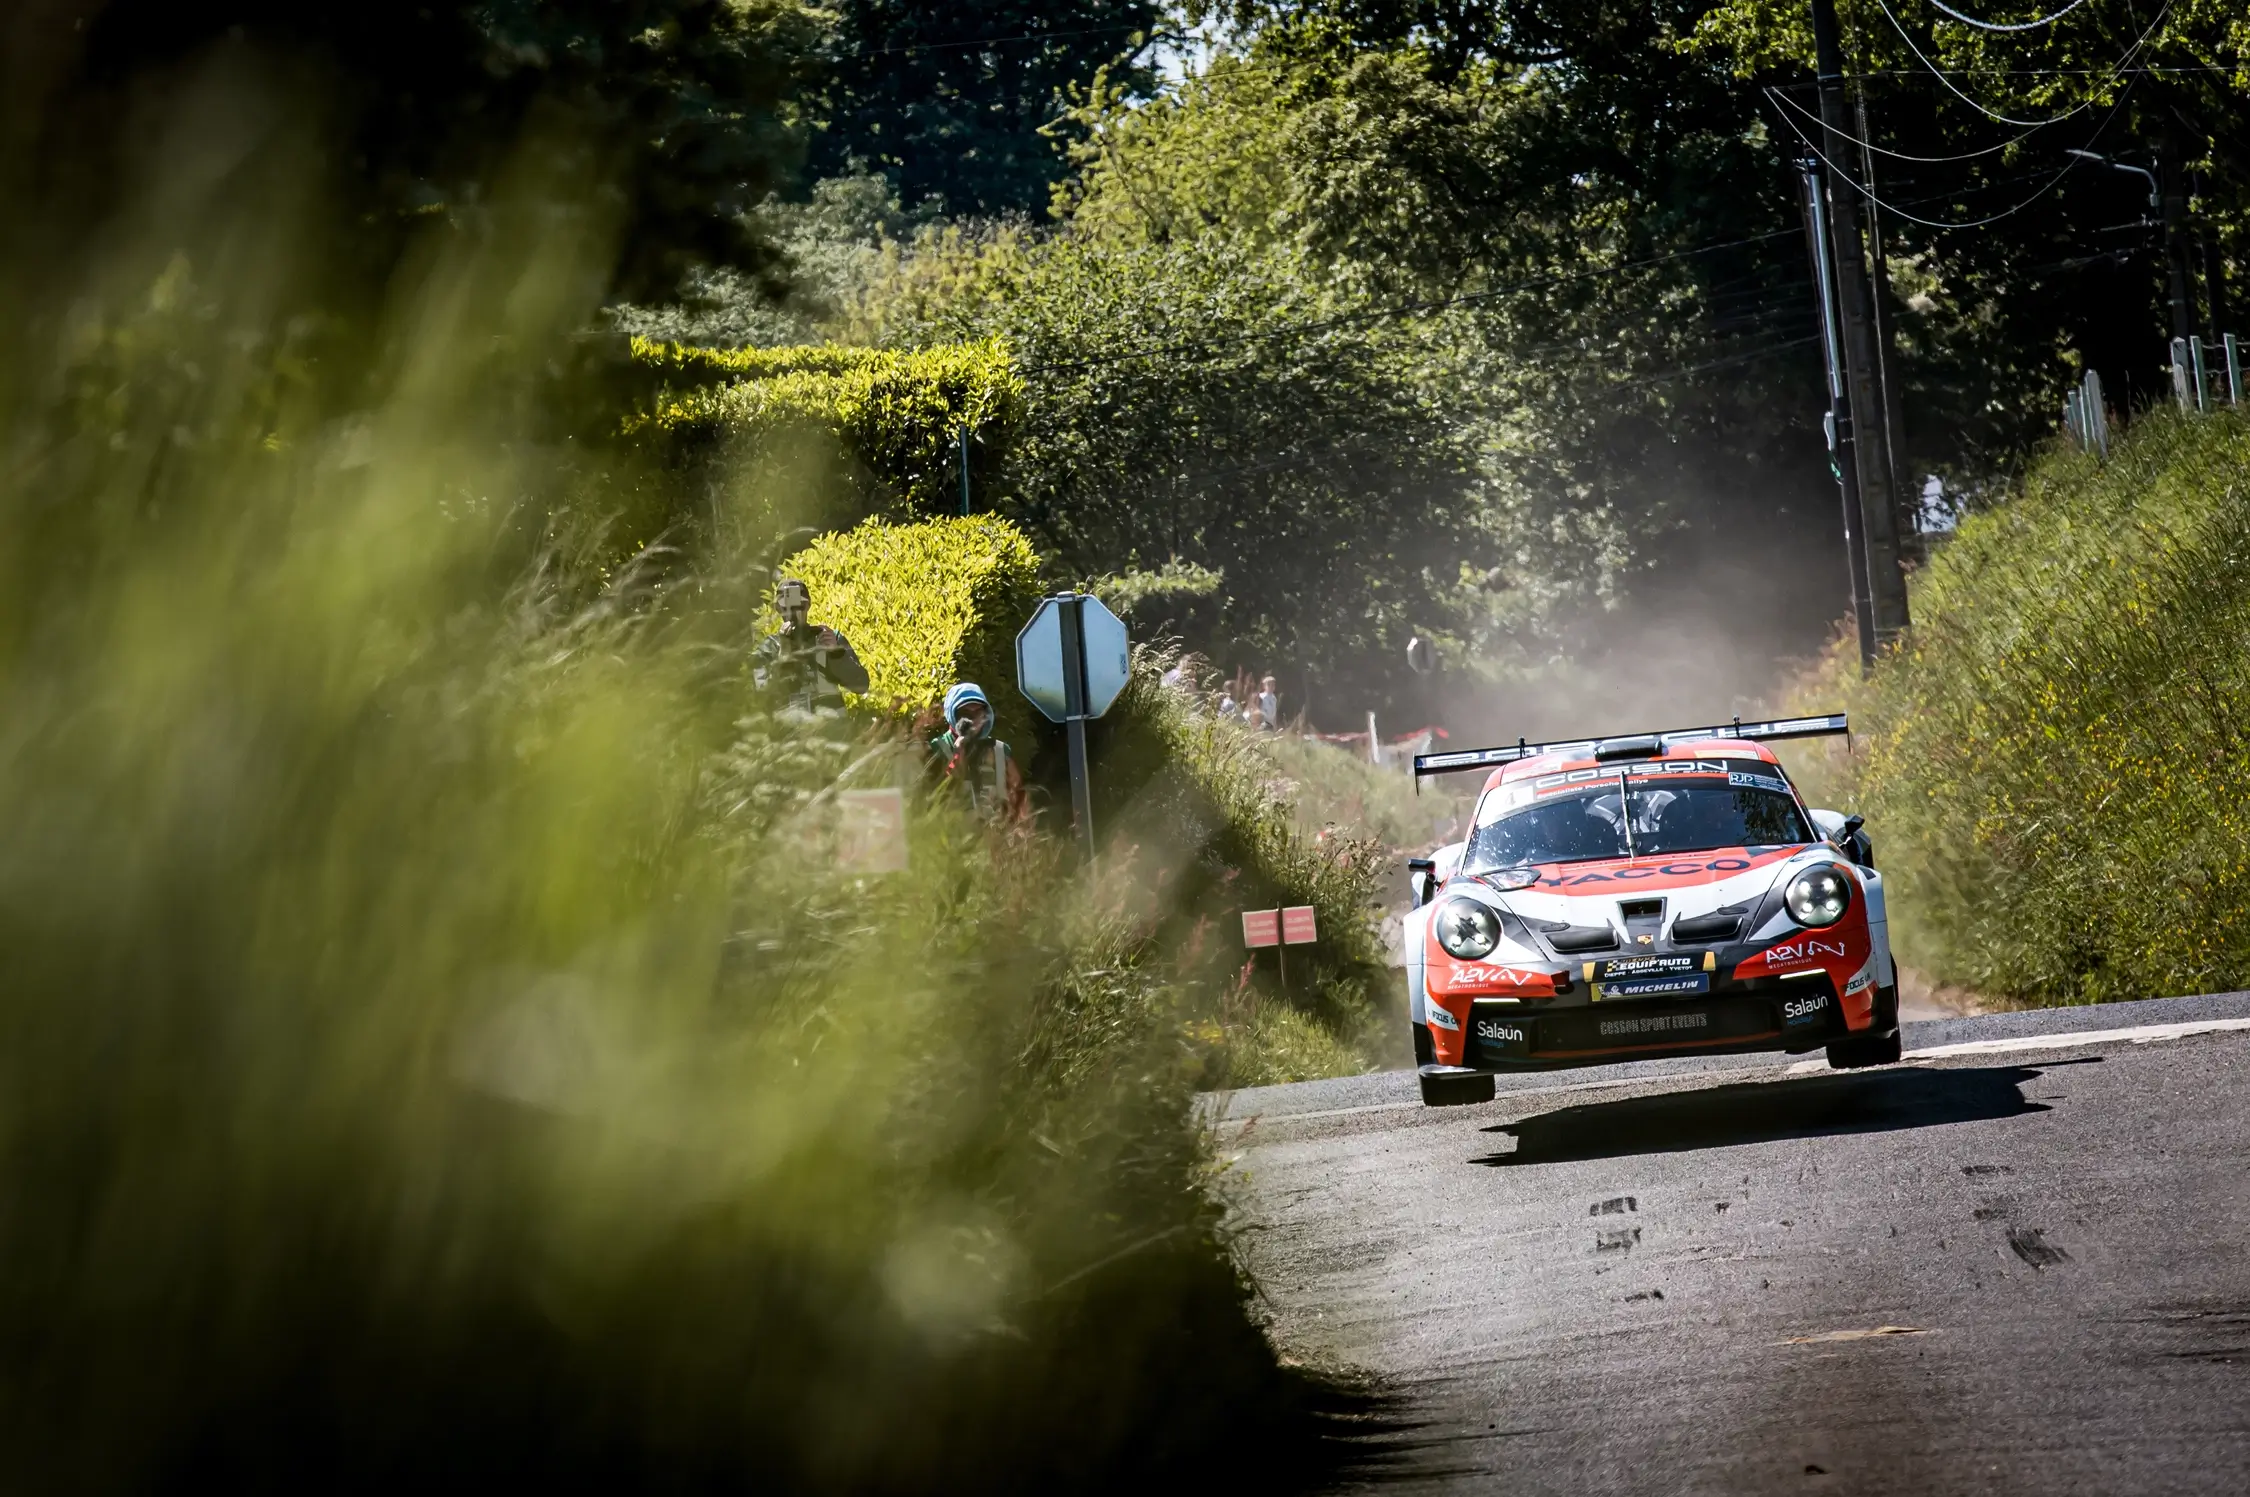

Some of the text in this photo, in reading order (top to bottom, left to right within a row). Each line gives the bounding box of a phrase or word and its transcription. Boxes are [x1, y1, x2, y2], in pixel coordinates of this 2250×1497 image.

[1535, 759, 1728, 788] COSSON
[1585, 780, 1620, 791] Porsche
[1538, 859, 1751, 888] YACCO
[1766, 944, 1802, 963] A2V
[1619, 958, 1691, 970] EQUIP'AUTO
[1448, 967, 1497, 985] A2V
[1625, 981, 1698, 994] MICHELIN
[1477, 1021, 1523, 1041] Salaün
[1640, 1016, 1671, 1033] SPORT
